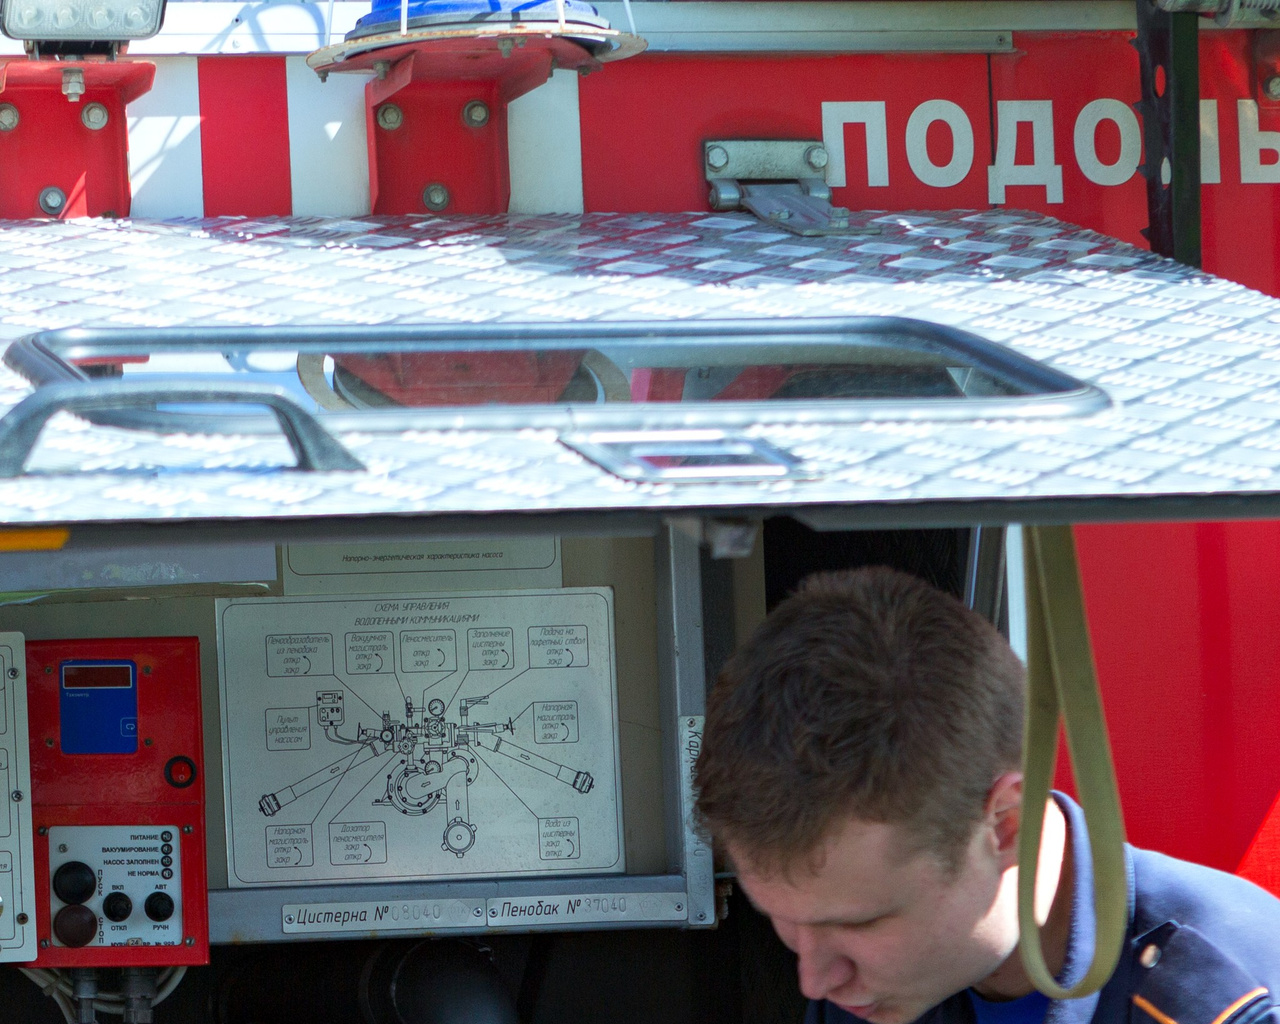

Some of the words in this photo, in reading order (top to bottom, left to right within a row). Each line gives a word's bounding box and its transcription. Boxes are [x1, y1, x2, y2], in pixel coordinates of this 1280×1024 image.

[375, 604, 399, 612] СХЕМА
[402, 602, 450, 611] УПРАВЛЕНИЯ
[354, 617, 408, 626] ВОДОПЕННЫМИ
[409, 614, 480, 624] КОММУНИКАЦИЯМИ
[472, 629, 511, 638] Заполнение
[540, 628, 563, 636] Подача
[268, 636, 329, 645] Пенообразователь
[351, 634, 387, 644] Вакуумная
[402, 634, 453, 643] Пеносмеситель
[530, 639, 563, 648] лафетный
[565, 637, 585, 645] ствол
[287, 645, 317, 654] пенобака
[547, 658, 562, 666] закр
[542, 704, 573, 712] Напорная
[277, 715, 298, 725] Пульт
[269, 725, 307, 736] управления
[545, 820, 561, 828] Вода
[274, 828, 306, 836] Напорная
[341, 825, 370, 833] Дозатор
[334, 835, 384, 843] пеносмесителя
[501, 900, 559, 917] Пенобак
[297, 909, 367, 926] Цистерна
